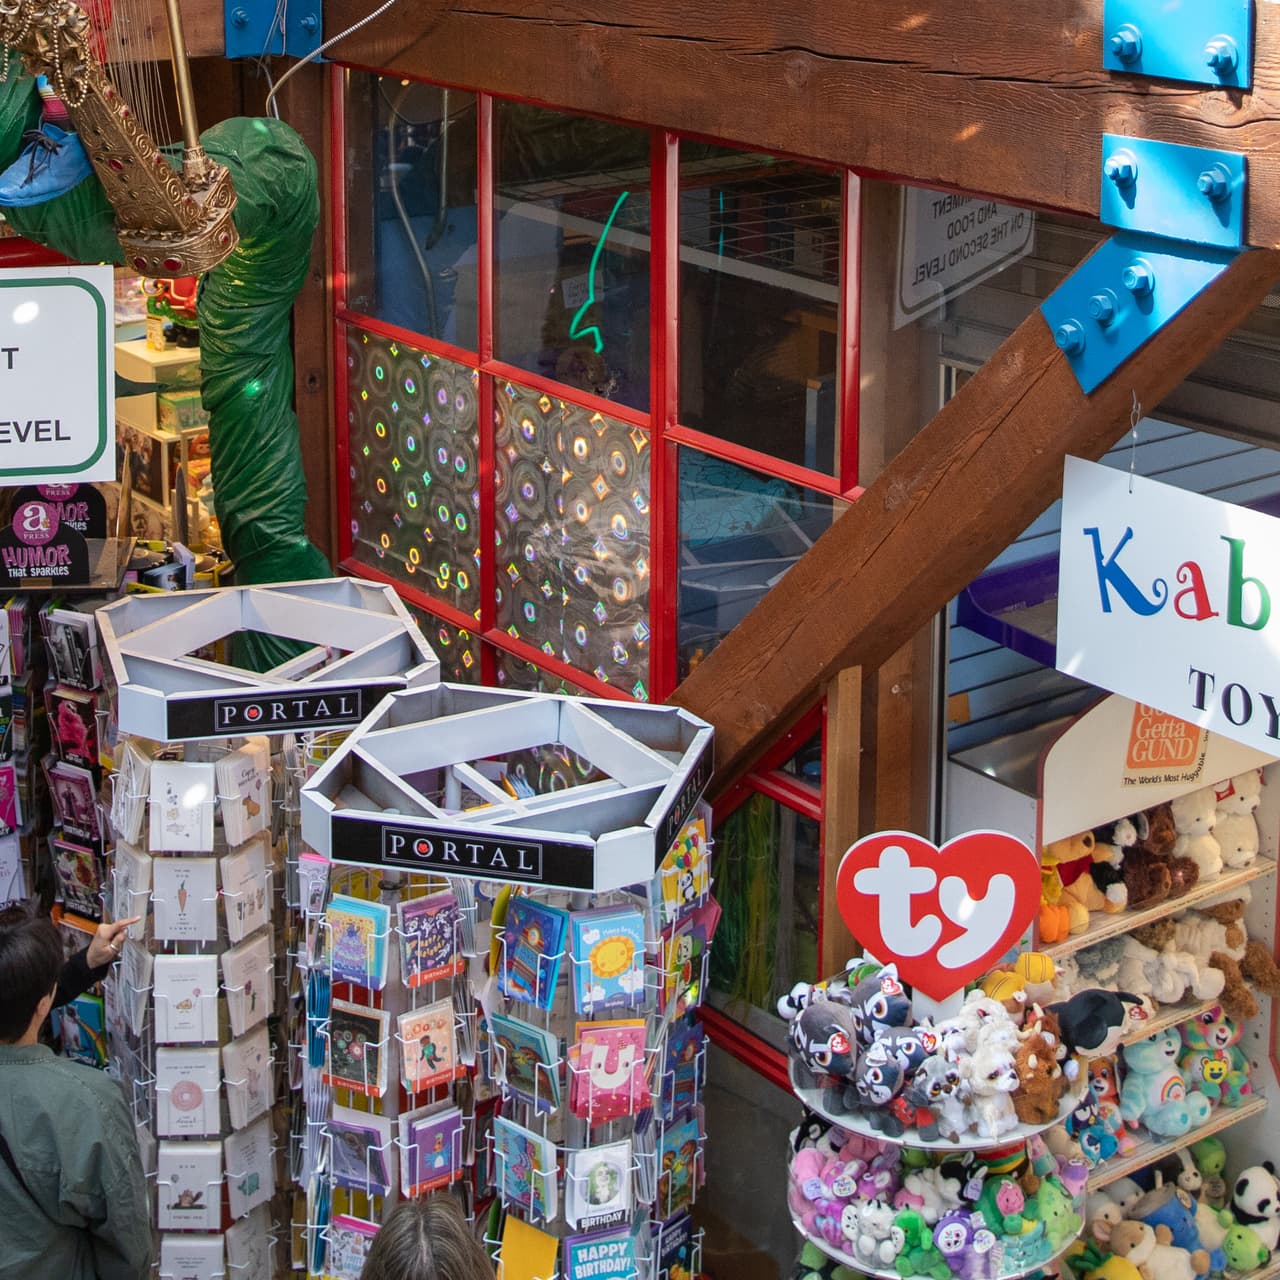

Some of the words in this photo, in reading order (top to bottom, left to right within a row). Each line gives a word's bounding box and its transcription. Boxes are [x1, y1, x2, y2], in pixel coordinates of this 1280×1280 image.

[2, 544, 72, 568] HUMOR
[223, 697, 353, 724] PORTAL
[1136, 718, 1185, 740] Getta
[1132, 738, 1194, 762] GUND
[1124, 777, 1137, 785] The
[1138, 775, 1162, 784] World's
[1164, 774, 1180, 782] Most
[389, 834, 533, 870] PORTAL
[853, 845, 1016, 969] ty
[581, 1211, 623, 1227] BIRTHDAY
[577, 1243, 628, 1262] HAPPY
[574, 1257, 631, 1276] BIRTHDAY!
